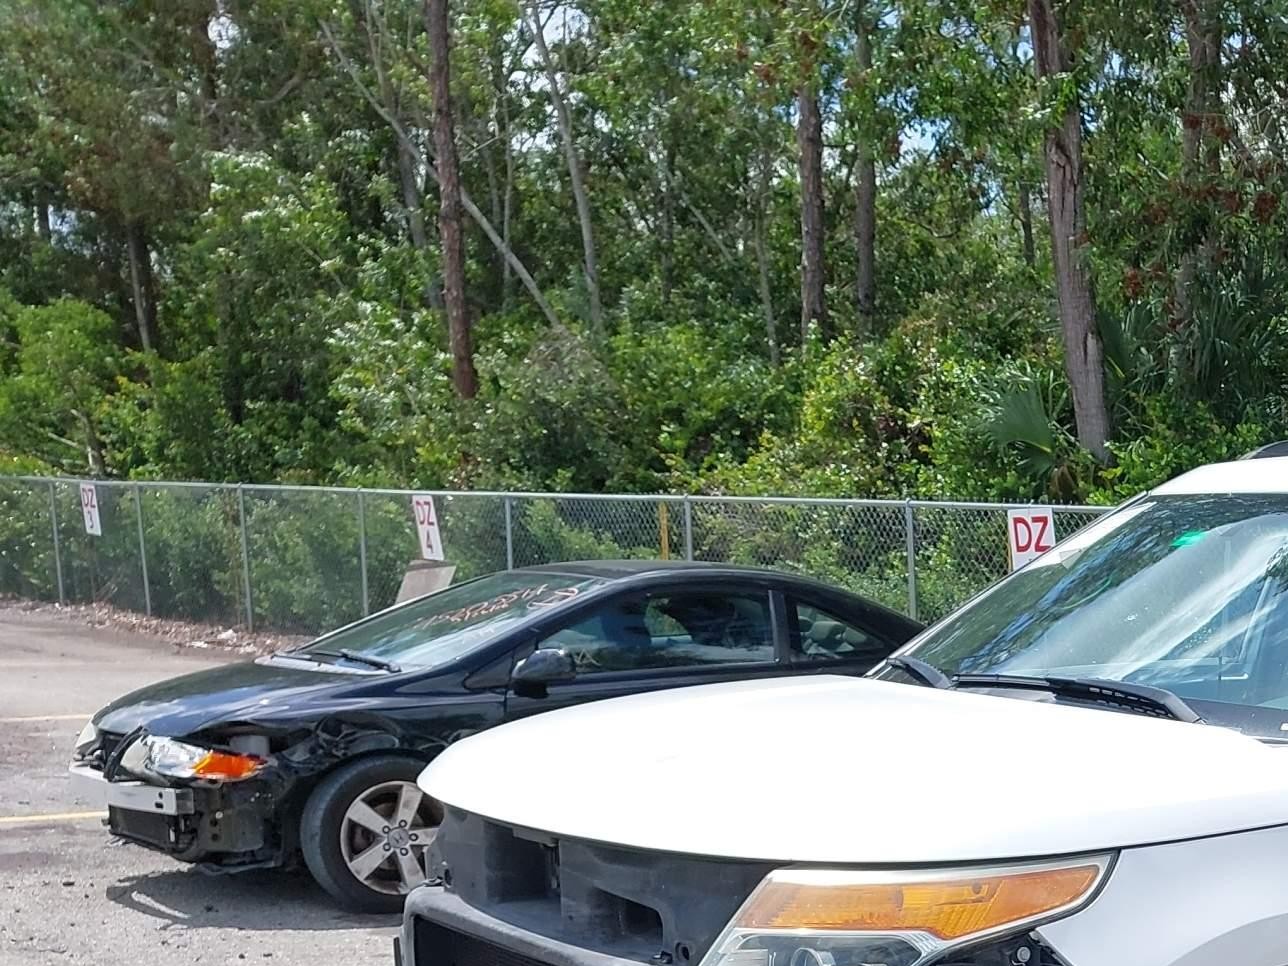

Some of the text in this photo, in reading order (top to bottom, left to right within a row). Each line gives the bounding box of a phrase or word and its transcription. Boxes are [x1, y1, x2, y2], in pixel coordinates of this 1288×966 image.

[82, 488, 96, 508] DZ
[416, 501, 435, 526] DZ
[426, 531, 435, 554] 4
[1013, 516, 1051, 553] DZ
